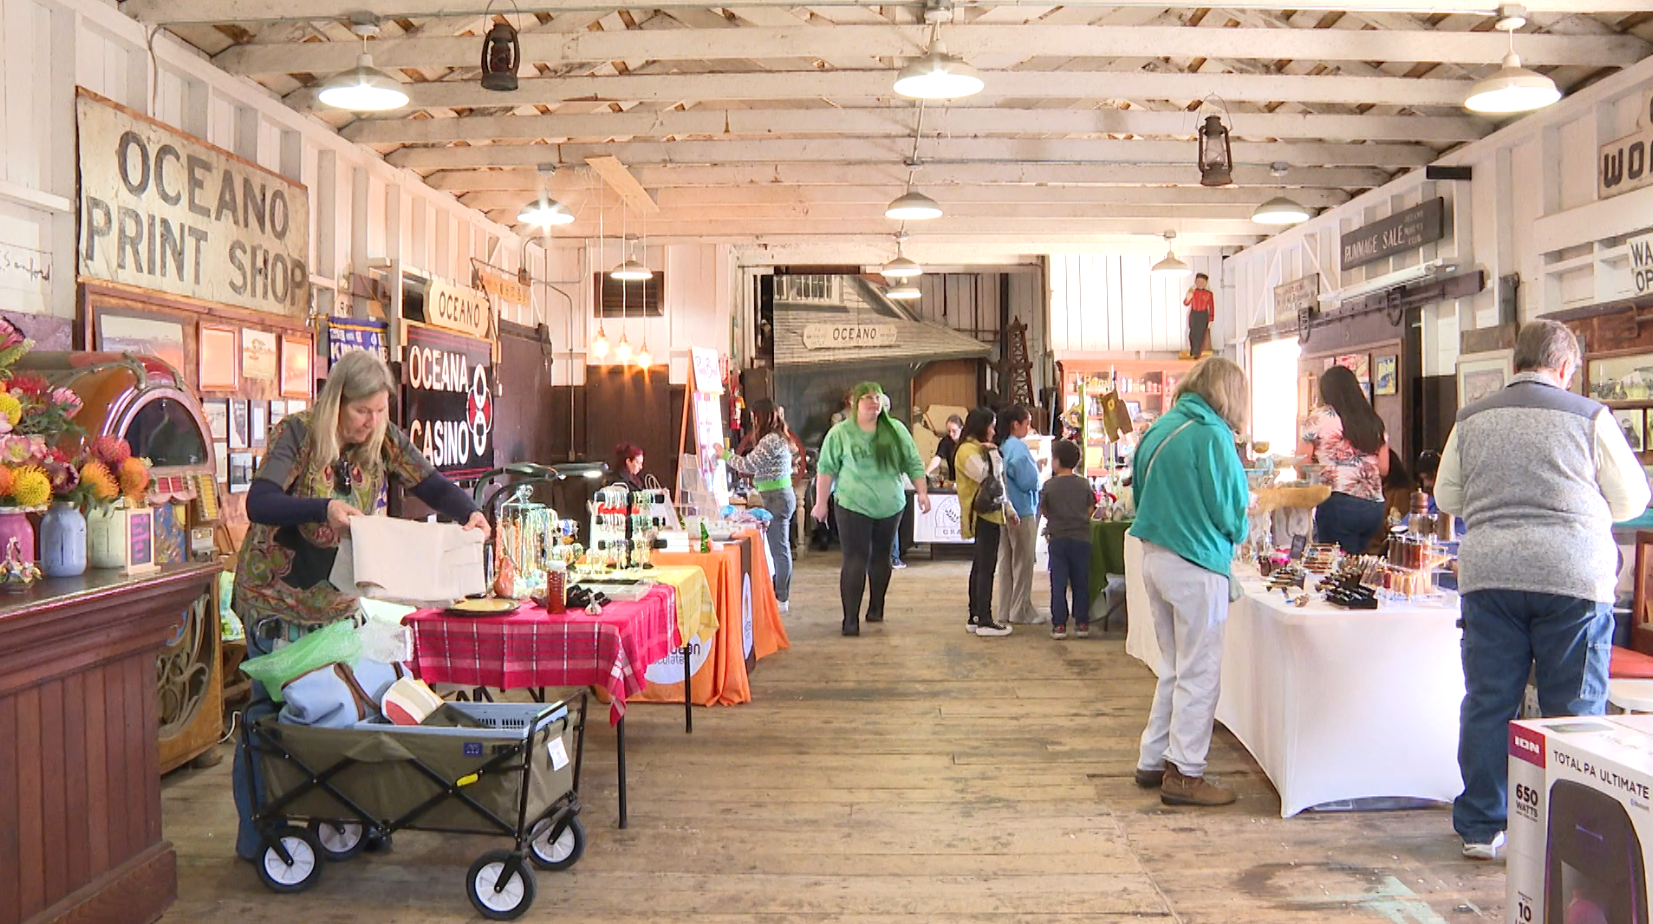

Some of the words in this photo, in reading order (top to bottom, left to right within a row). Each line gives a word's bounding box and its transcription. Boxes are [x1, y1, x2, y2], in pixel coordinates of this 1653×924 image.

[1604, 140, 1653, 189] WO
[117, 131, 289, 240] OCEANO
[86, 196, 208, 285] PRINT
[228, 240, 307, 307] SHOP
[1382, 224, 1405, 249] SALE
[438, 291, 481, 328] OCEANO
[832, 327, 877, 341] OCEANO
[409, 345, 469, 393] OCEANA
[409, 418, 470, 467] CASINO
[1515, 735, 1540, 754] ION
[1553, 750, 1582, 773] TOTAL
[1584, 762, 1597, 778] PA
[1600, 769, 1650, 800] ULTIMATE
[1516, 783, 1538, 806] 650
[1516, 800, 1538, 818] WATTS
[1518, 902, 1531, 922] 10
